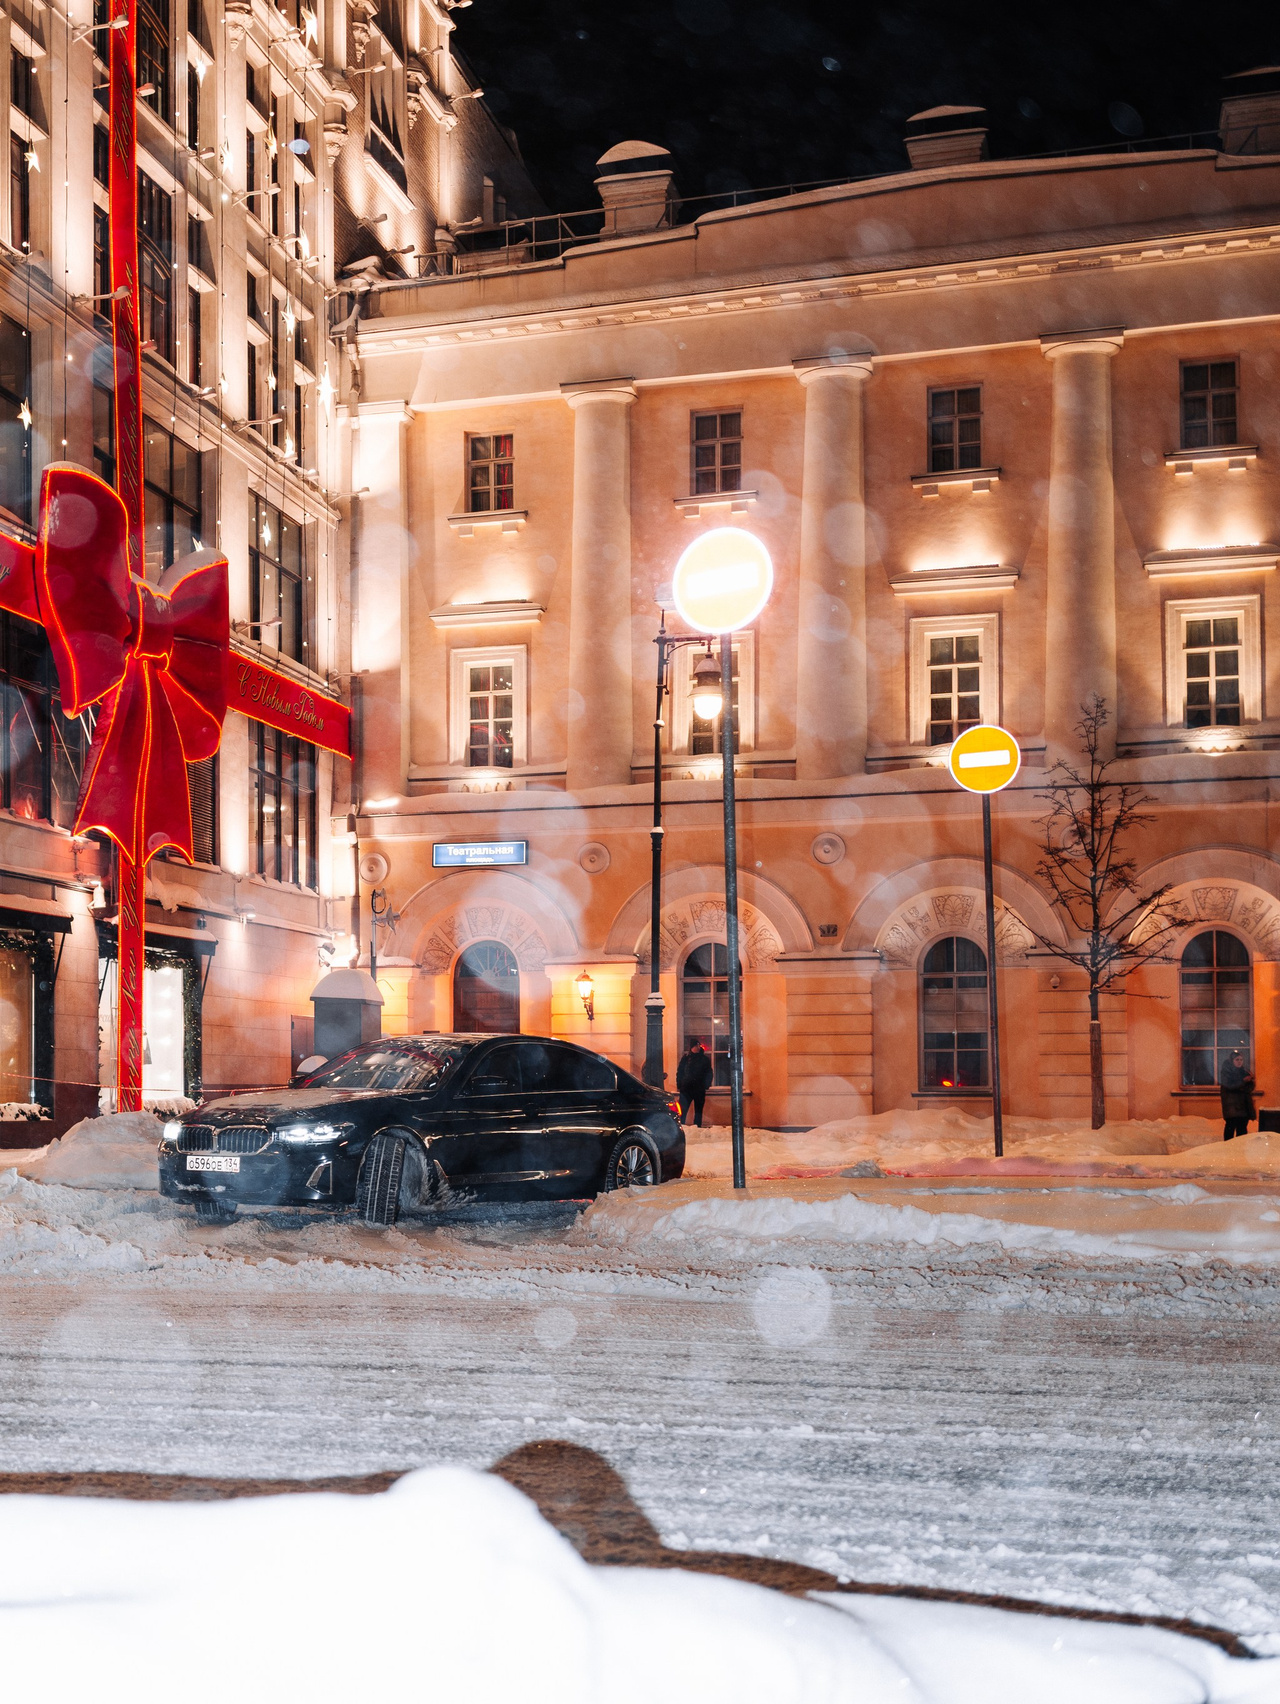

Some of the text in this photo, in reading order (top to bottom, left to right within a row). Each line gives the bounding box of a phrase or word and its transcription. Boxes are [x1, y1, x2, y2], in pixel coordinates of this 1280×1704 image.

[237, 662, 325, 732] С Новым Годом
[446, 845, 514, 857] Театральная
[122, 865, 141, 938] Yea
[121, 947, 138, 1026] New
